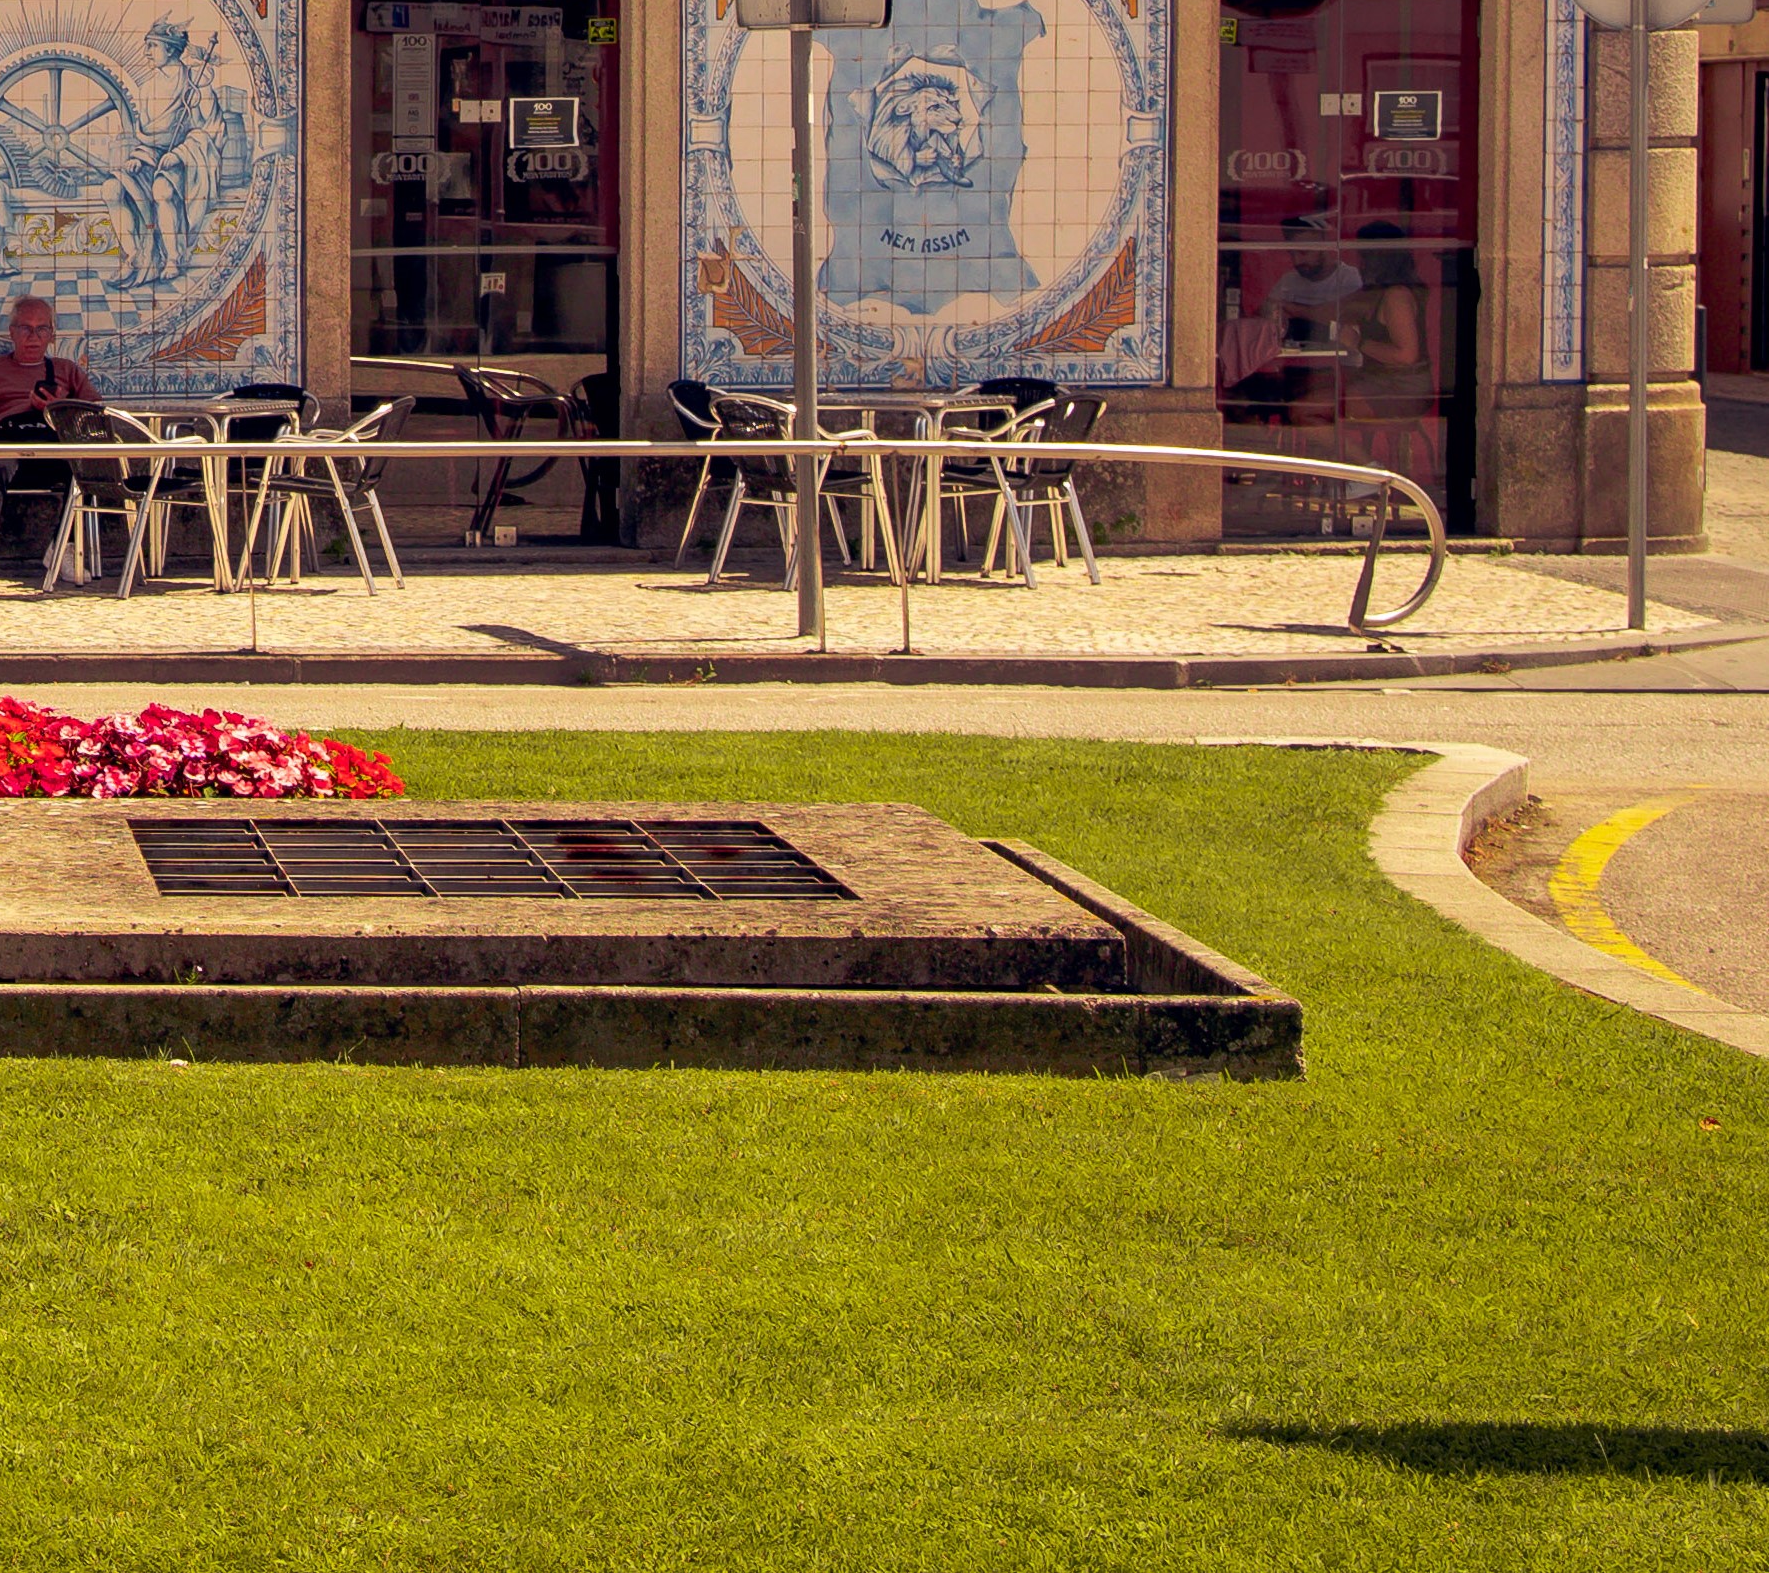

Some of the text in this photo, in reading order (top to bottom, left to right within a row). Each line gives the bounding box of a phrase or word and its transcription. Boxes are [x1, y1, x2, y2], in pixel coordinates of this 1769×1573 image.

[401, 36, 428, 47] 100
[533, 103, 553, 112] 100
[386, 154, 438, 173] 100
[522, 153, 572, 171] 100
[1242, 151, 1291, 171] 100
[1383, 150, 1432, 168] 100
[880, 228, 970, 253] NEM ASSIM
